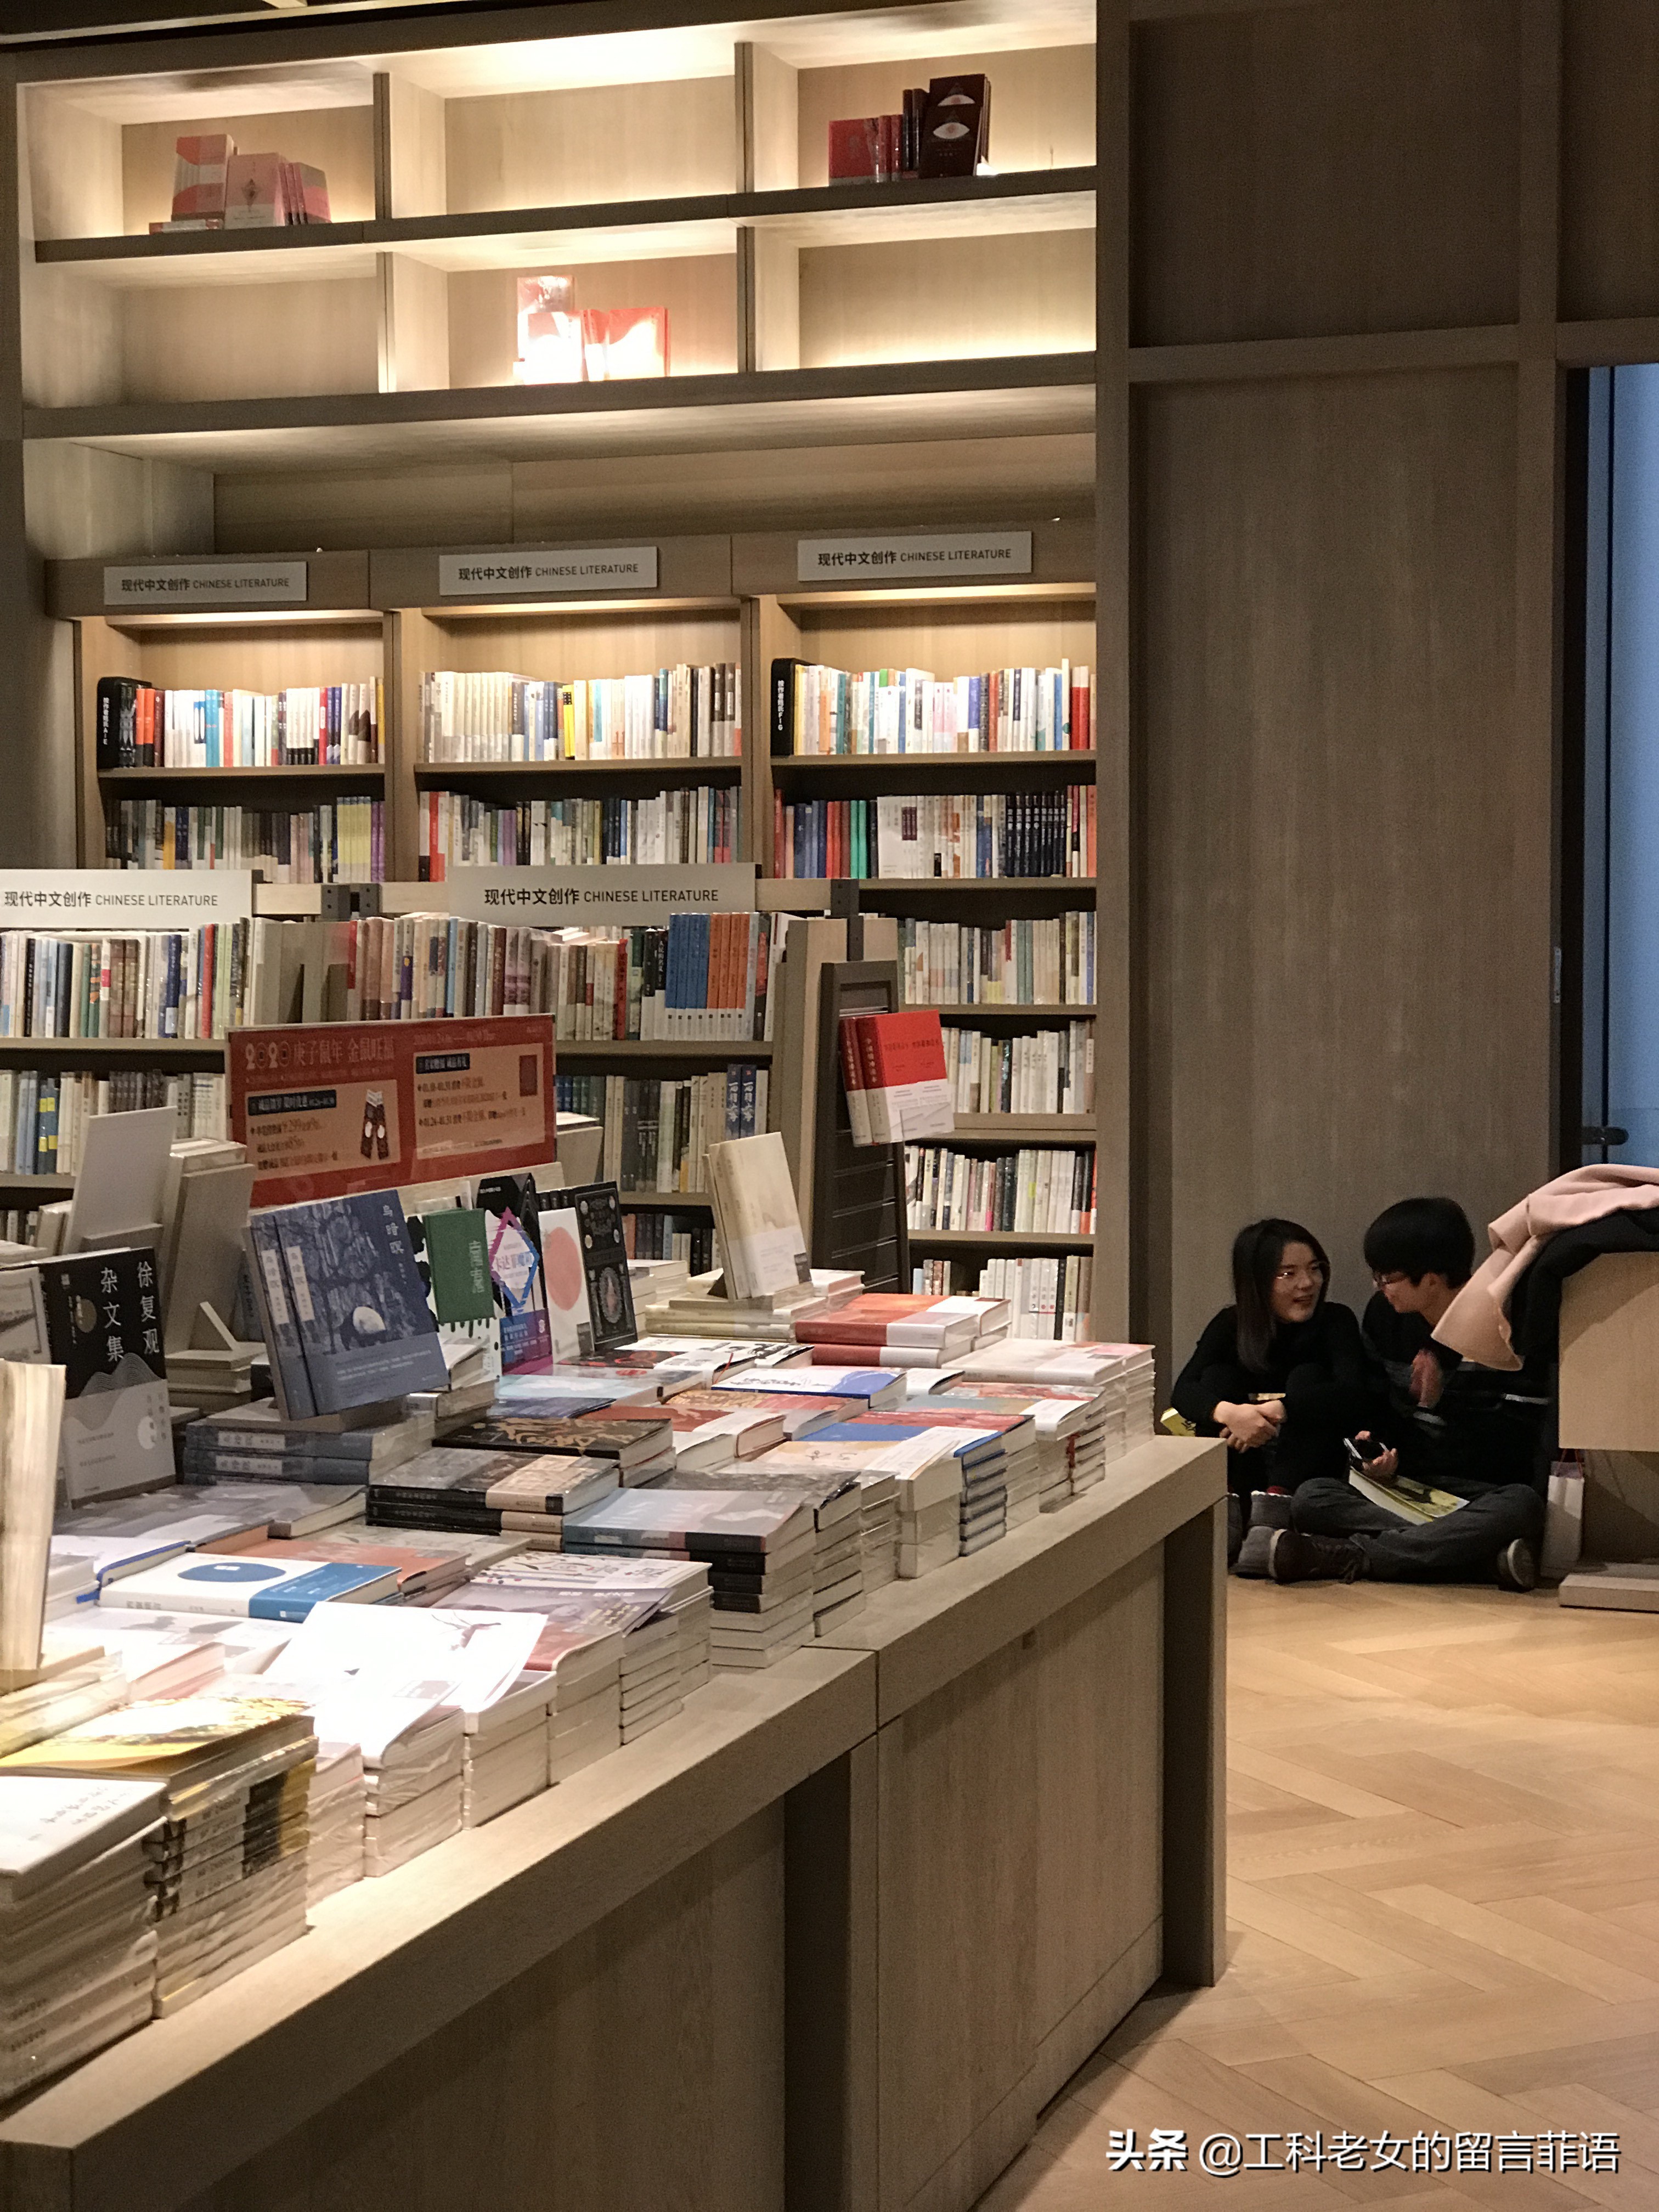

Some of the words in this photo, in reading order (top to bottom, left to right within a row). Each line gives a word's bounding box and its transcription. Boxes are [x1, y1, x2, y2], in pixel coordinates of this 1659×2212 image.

[817, 550, 897, 566] 现代中文创作
[900, 551, 945, 562] CHINESE
[948, 549, 1011, 561] LITERATURE
[459, 566, 532, 581] 现代中文创作
[535, 565, 577, 576] CHINESE
[580, 562, 639, 575] LITERATURE
[121, 578, 190, 592] 现代中文创作
[193, 579, 232, 589] CHINESE
[234, 577, 290, 589] LITERATURE
[4, 891, 91, 907] 现代中文创作
[95, 895, 145, 906] CHINESE
[149, 894, 218, 906] LITERATURE
[484, 888, 579, 906] 现代中文创作
[584, 891, 638, 903] CHINESE
[642, 889, 719, 901] LITERATURE
[100, 1267, 124, 1362] 杂文集
[137, 1261, 160, 1355] 徐复观
